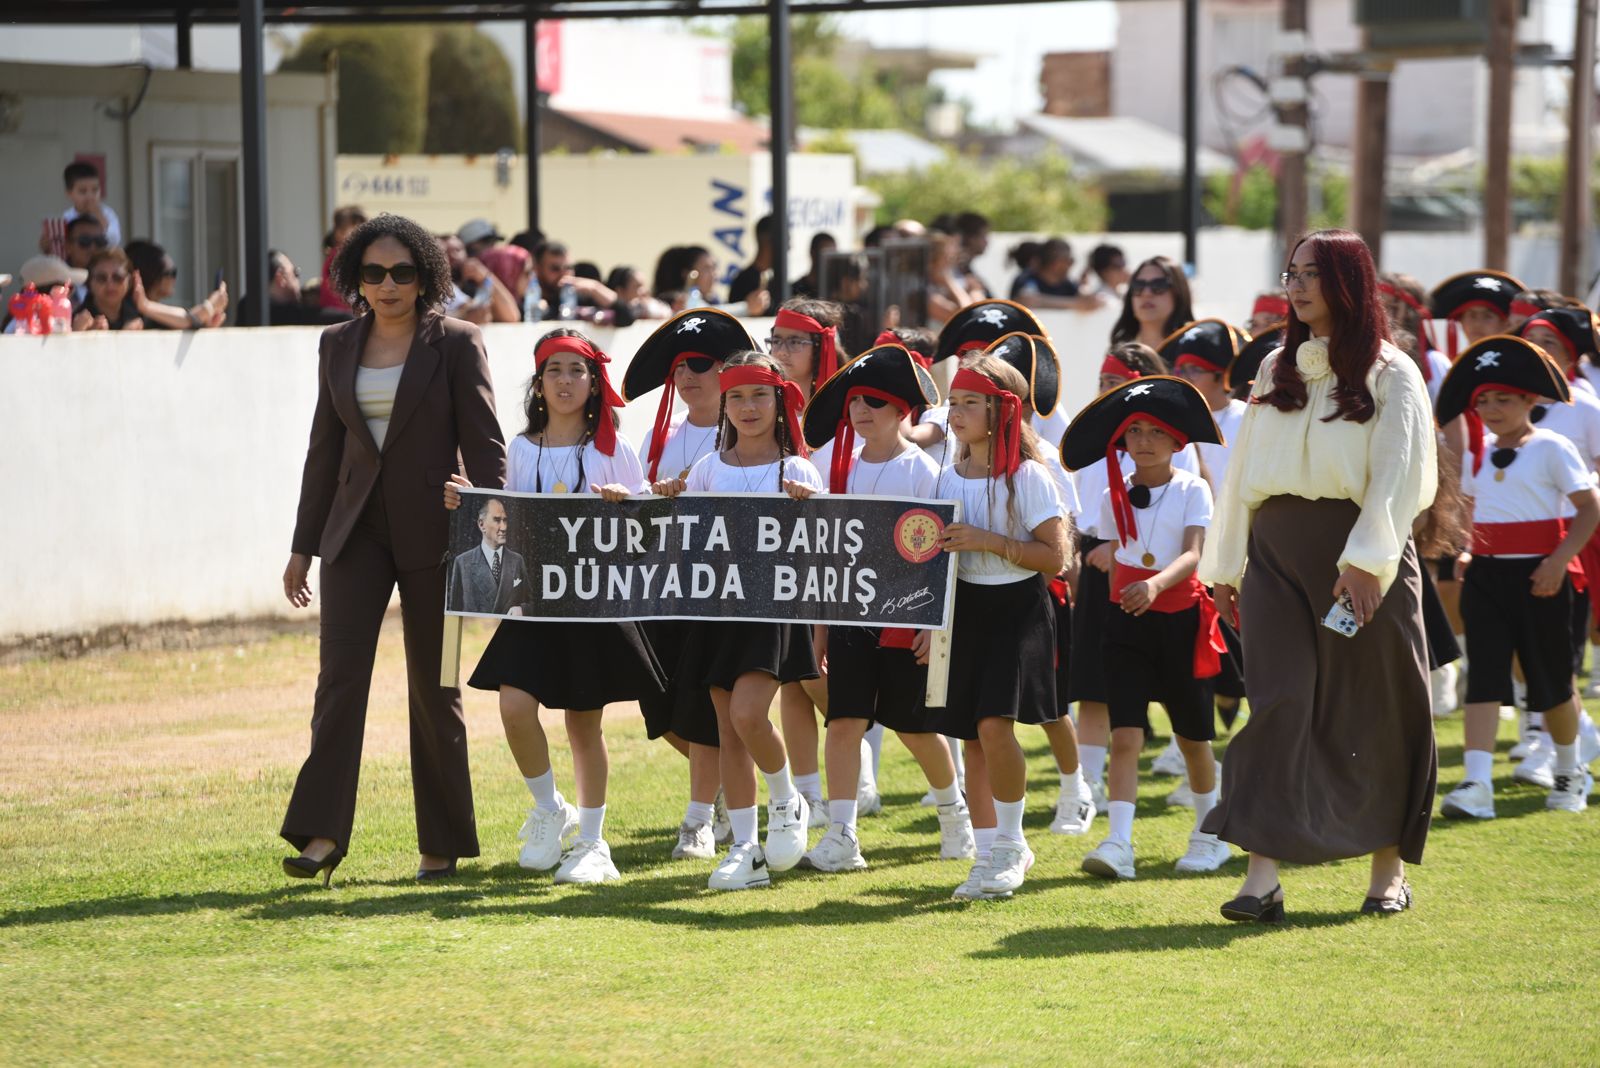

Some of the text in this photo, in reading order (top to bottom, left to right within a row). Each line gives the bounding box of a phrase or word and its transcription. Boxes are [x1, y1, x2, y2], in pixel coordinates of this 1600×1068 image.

[558, 515, 865, 567] YURTTA BARIŞ
[541, 557, 878, 616] DÜNYADA BARIŞ
